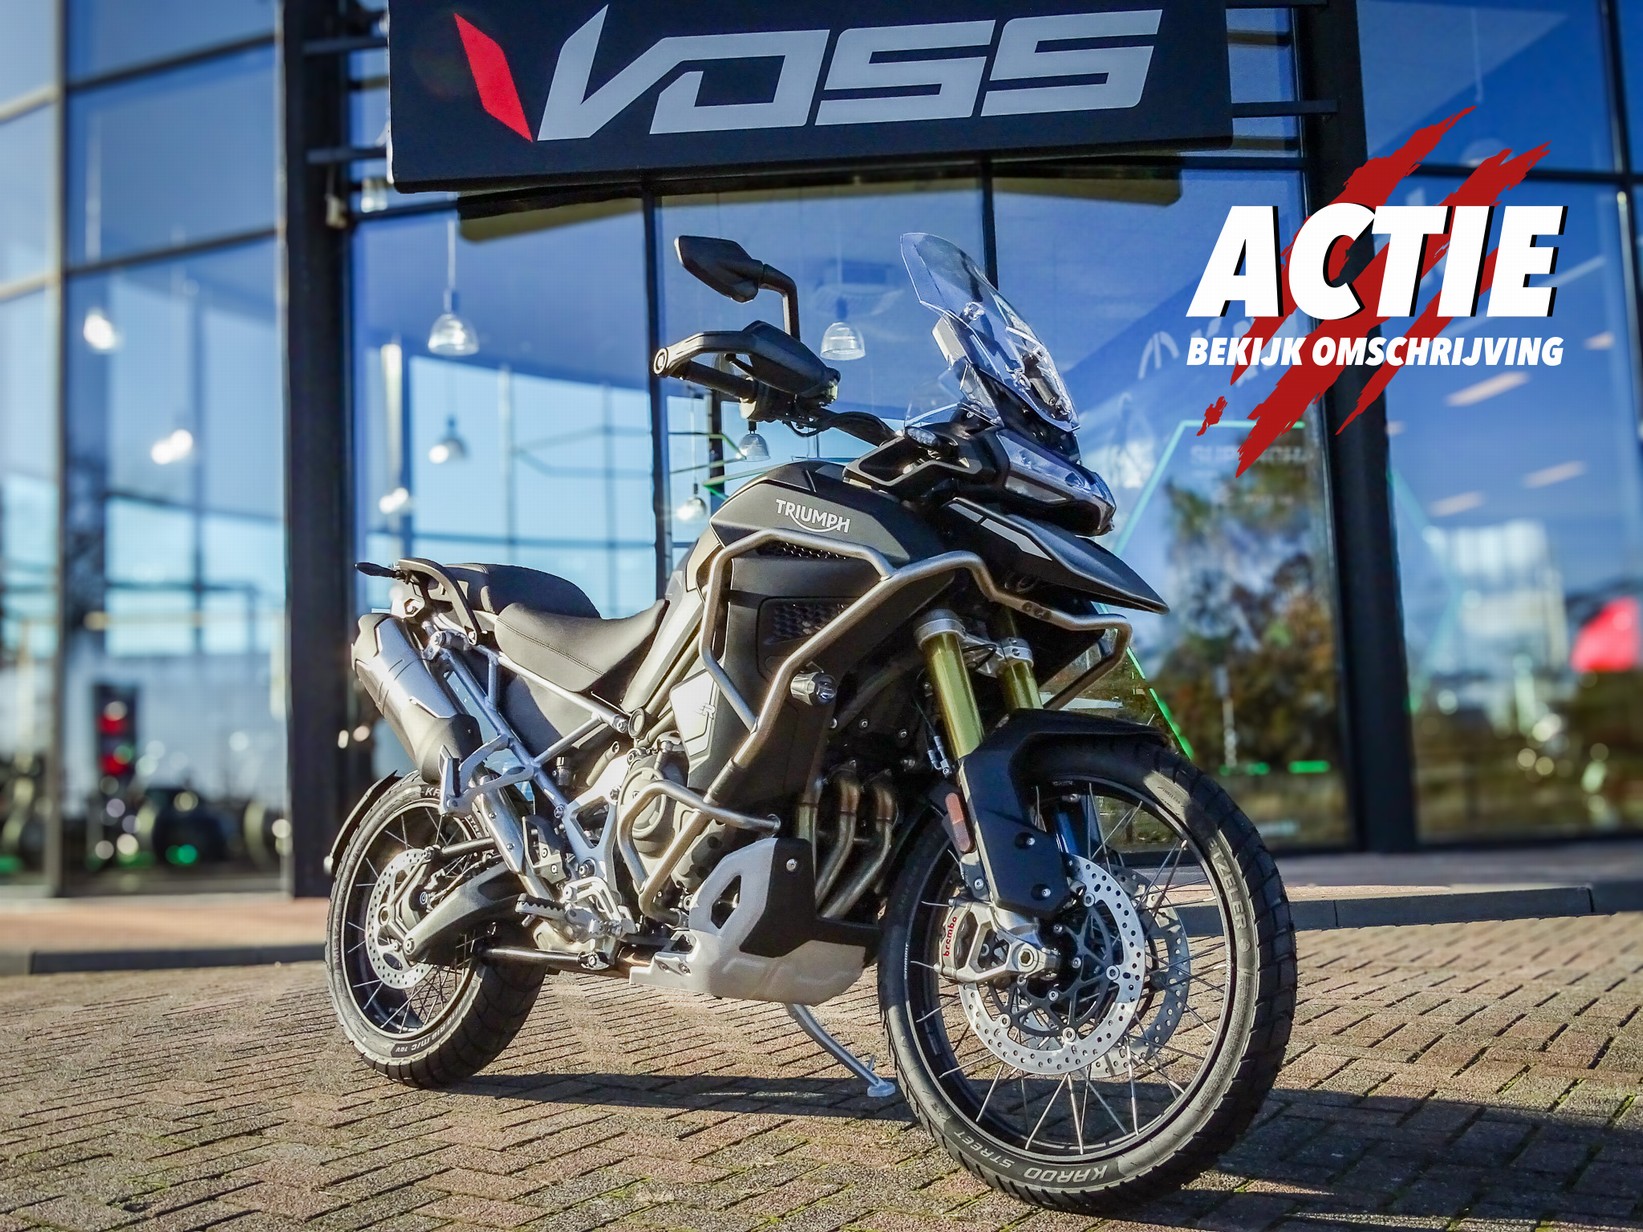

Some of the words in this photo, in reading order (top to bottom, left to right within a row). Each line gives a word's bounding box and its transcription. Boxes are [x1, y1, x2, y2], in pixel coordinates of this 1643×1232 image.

[536, 7, 1163, 141] VOSS
[775, 498, 851, 533] TRIUMPH
[1207, 838, 1248, 930] ETZELER
[943, 916, 958, 957] brembo
[953, 1129, 1016, 1169] STREET
[1023, 1164, 1108, 1184] KAROO
